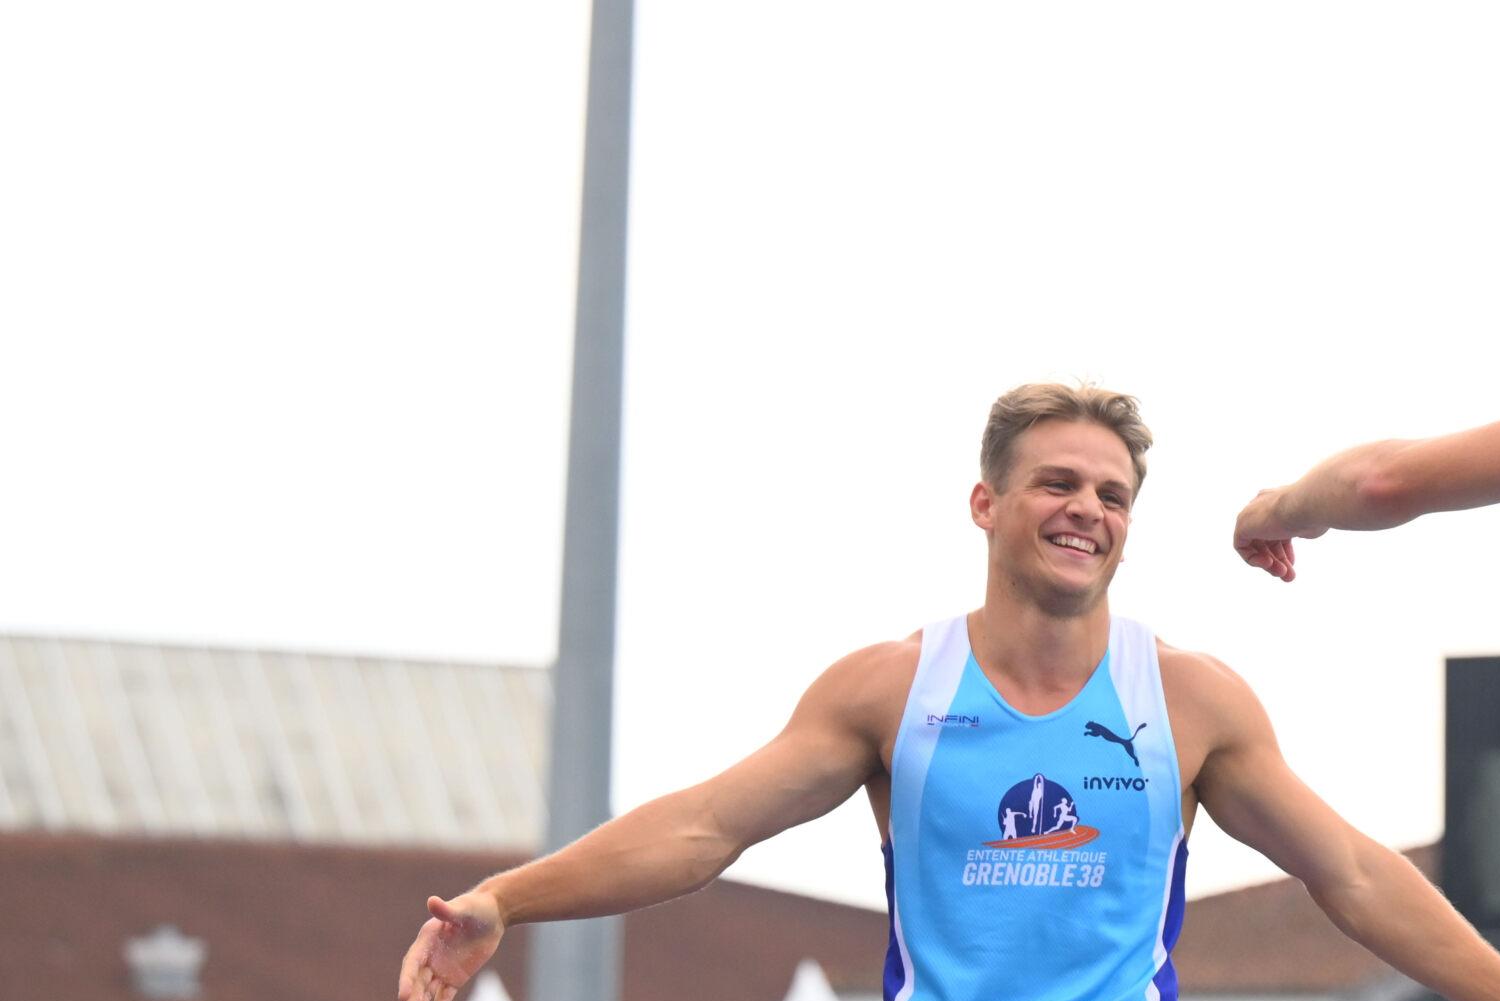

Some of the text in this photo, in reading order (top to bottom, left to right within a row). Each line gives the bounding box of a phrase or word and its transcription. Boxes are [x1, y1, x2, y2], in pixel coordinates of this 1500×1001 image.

[927, 714, 980, 727] INFINI
[966, 849, 1026, 862] ENTENTE
[962, 862, 1077, 887] GRENOBLE
